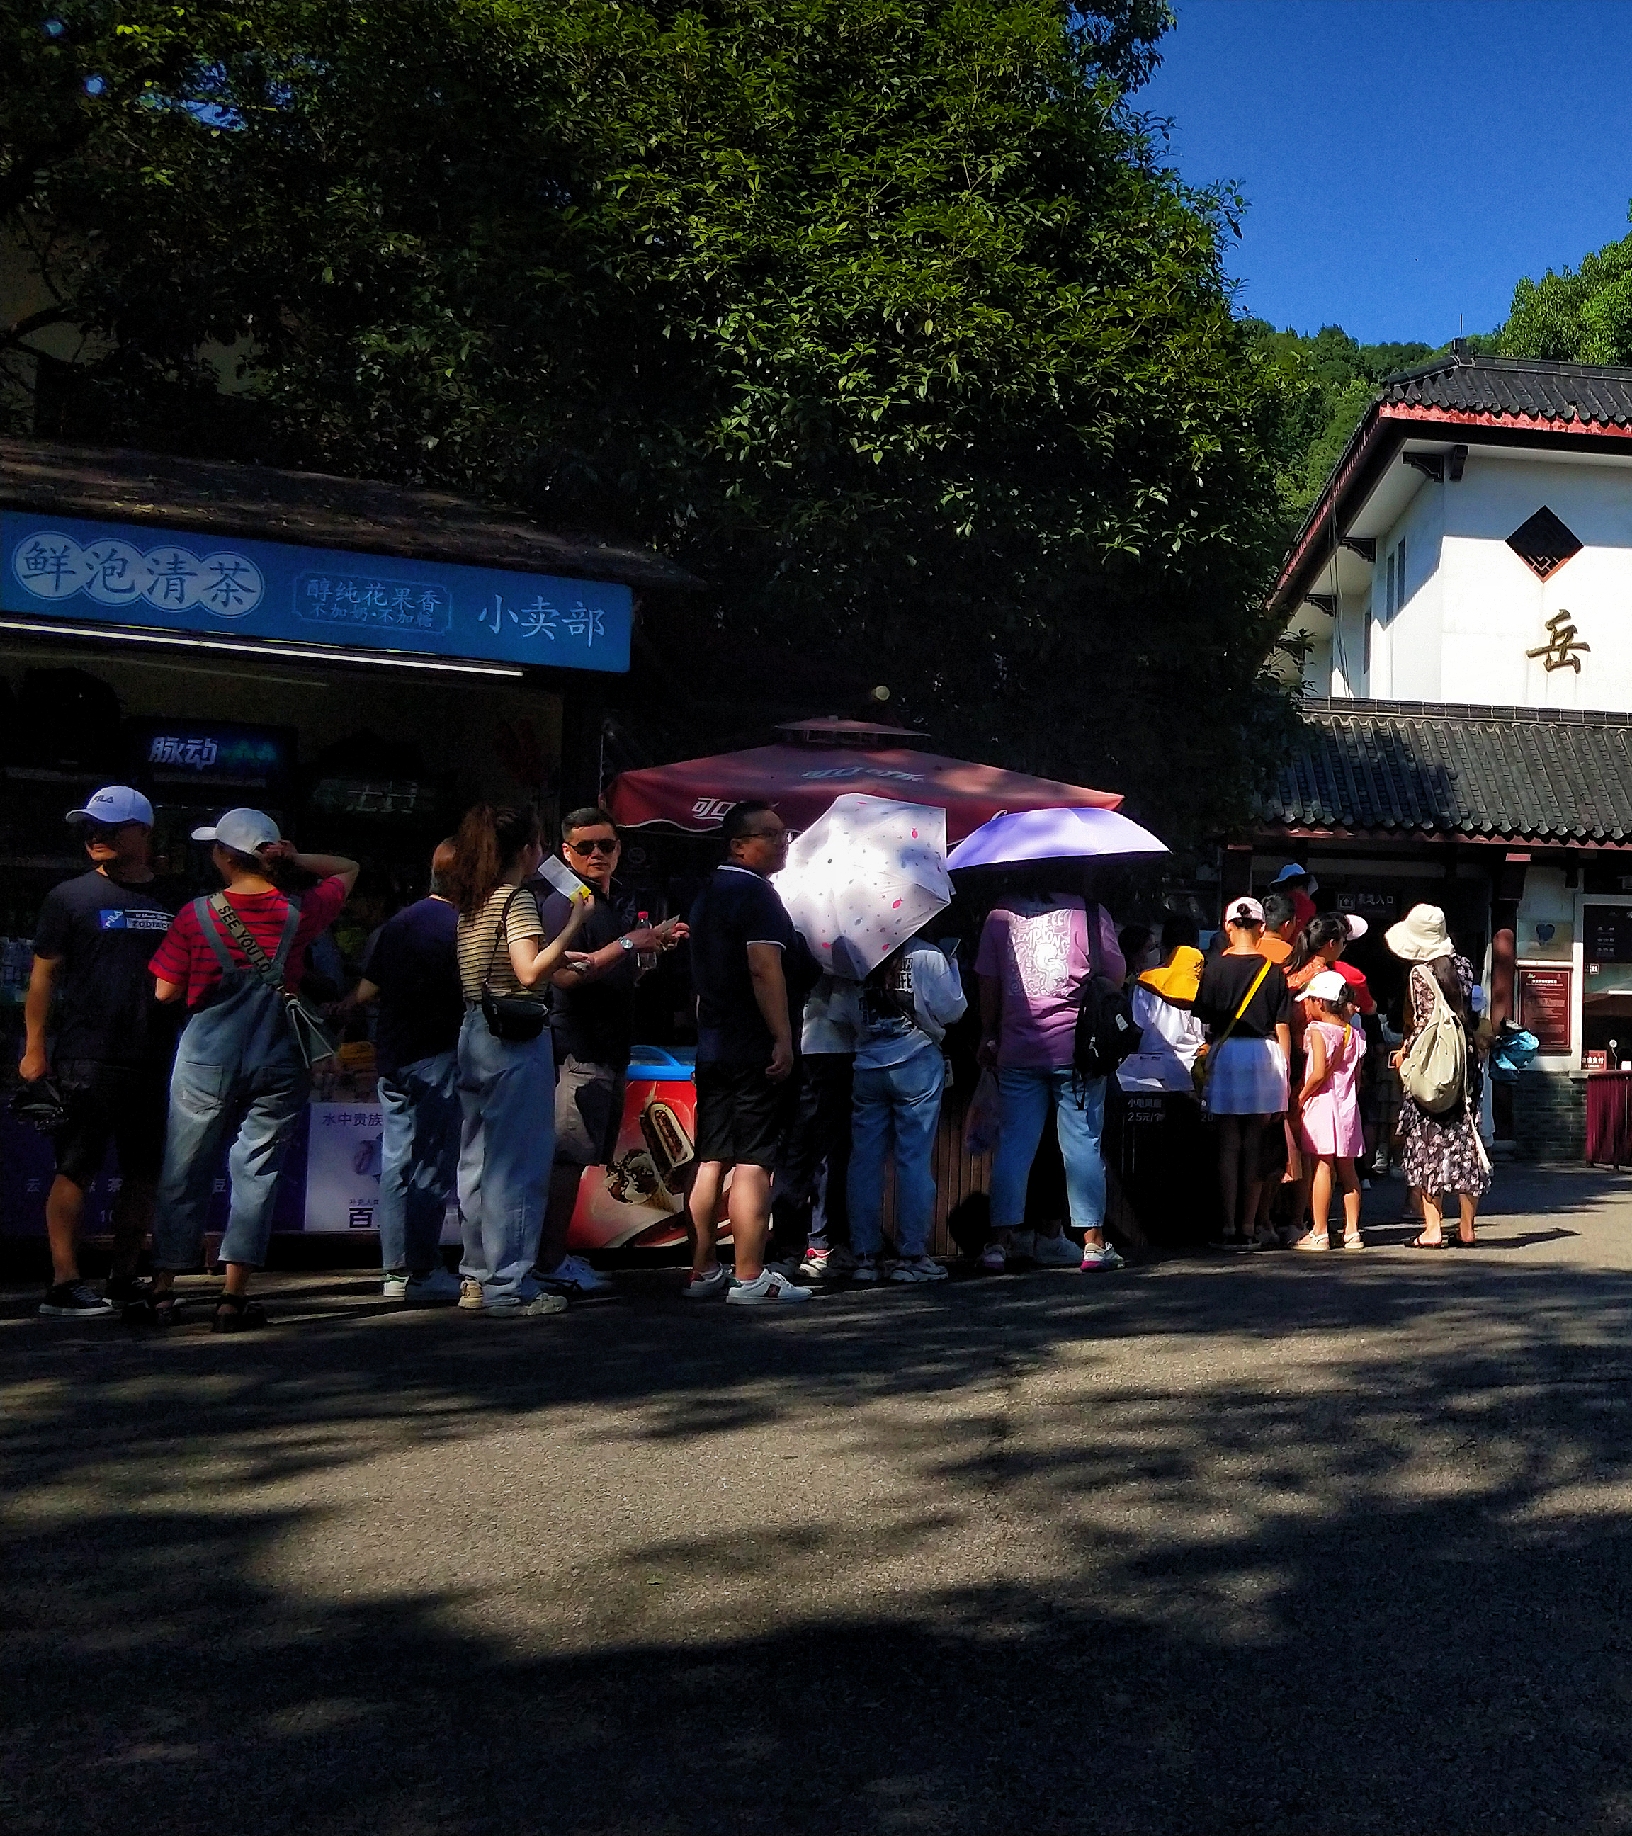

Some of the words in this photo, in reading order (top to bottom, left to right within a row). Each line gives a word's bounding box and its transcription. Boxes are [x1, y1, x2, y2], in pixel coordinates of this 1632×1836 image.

[23, 541, 256, 607] 鲜泡清茶
[306, 577, 442, 614] 醇纯花果香
[477, 594, 605, 648] 小卖部
[148, 735, 219, 769] 脉动
[218, 905, 239, 930] SEE
[236, 929, 261, 956] YOU
[322, 1112, 384, 1127] 水中贵族
